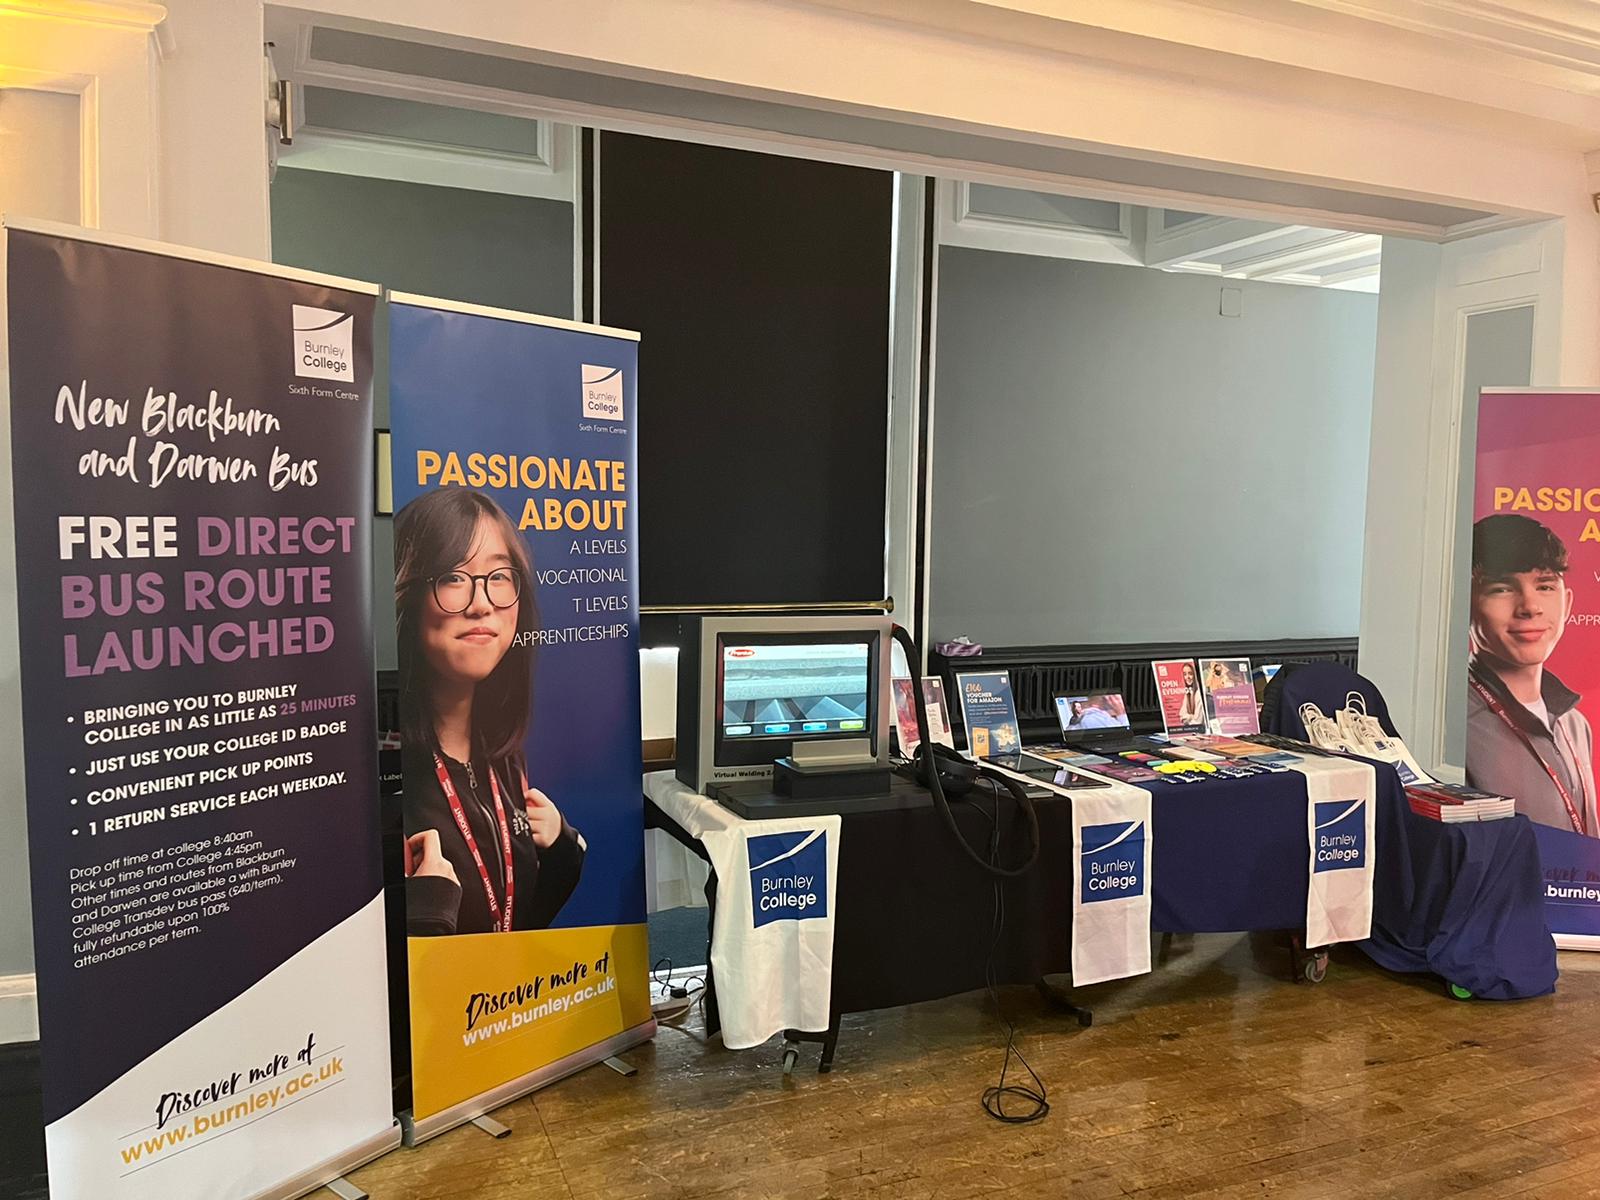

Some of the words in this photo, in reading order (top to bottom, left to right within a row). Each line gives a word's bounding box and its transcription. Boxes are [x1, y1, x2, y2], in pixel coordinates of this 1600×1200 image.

[303, 354, 347, 373] College
[304, 340, 345, 359] Burnley
[54, 379, 130, 431] New
[141, 387, 281, 442] Blackburn
[288, 384, 310, 395] Sixth
[312, 386, 333, 398] Form
[334, 389, 359, 401] Centre
[587, 401, 619, 415] College
[588, 390, 617, 404] Burnley
[78, 436, 140, 483] and
[147, 440, 257, 489] Darwen
[268, 446, 319, 492] Bus
[416, 450, 626, 492] PASSIONATE
[518, 498, 627, 531] ABOUT
[1493, 486, 1600, 512] PASSIO
[58, 516, 178, 560] FREE
[197, 516, 356, 556] DIRECT
[569, 540, 581, 555] A
[584, 539, 627, 555] LEVELS
[61, 572, 166, 619] BUS
[184, 566, 332, 611] ROUTE
[536, 568, 628, 585] VOCATIONAL
[572, 598, 580, 613] T
[586, 595, 628, 612] LEVELS
[63, 615, 335, 678] LAUNCHED
[511, 624, 629, 648] APPRENTICESHIPS
[84, 700, 170, 725] BRINGING
[173, 695, 209, 712] YOU
[212, 693, 234, 707] TO
[237, 684, 298, 704] BURNLEY
[1161, 680, 1179, 688] OPEN
[84, 721, 161, 745] COLLEGE
[165, 718, 183, 733] IN
[187, 714, 210, 729] AS
[214, 708, 255, 726] LITTLE
[258, 704, 277, 719] AS
[280, 703, 297, 715] 25
[301, 694, 357, 713] MINUTES
[85, 756, 126, 776] JUST
[130, 750, 160, 767] USE
[163, 742, 210, 762] YOUR
[213, 731, 278, 754] COLLEGE
[281, 729, 297, 742] ID
[300, 721, 347, 739] BADGE
[87, 773, 195, 806] CONVENIENT
[199, 765, 238, 784] PICK
[242, 761, 261, 777] UP
[264, 752, 314, 772] POINTS
[88, 821, 97, 836] 1
[103, 807, 166, 833] RETURN
[170, 793, 236, 818] SERVICE
[240, 784, 279, 804] EACH
[281, 771, 347, 795] WEEKDAY.
[69, 864, 102, 880] Drop
[104, 858, 121, 872] off
[123, 853, 149, 867] time
[151, 848, 164, 859] at
[166, 839, 212, 856] college
[213, 830, 253, 846] 8:40am
[1317, 848, 1360, 862] College
[1320, 834, 1357, 848] Burnley
[70, 879, 97, 894] Pick
[99, 876, 116, 888] up
[118, 868, 144, 883] time
[146, 861, 174, 876] from
[176, 850, 222, 868] College
[224, 841, 263, 857] 4:45pm
[71, 892, 107, 909] Other
[110, 883, 141, 900] times
[143, 875, 168, 890] and
[170, 869, 206, 884] routes
[208, 861, 234, 875] from
[235, 848, 285, 868] Blackburn
[761, 875, 814, 893] Burnley
[1088, 875, 1138, 891] College
[1091, 859, 1136, 876] Burnley
[71, 908, 98, 925] and
[101, 896, 147, 917] Darwen
[149, 890, 170, 903] are
[172, 876, 226, 897] available
[228, 874, 237, 883] a
[239, 868, 260, 881] with
[261, 857, 297, 874] Burnley
[72, 918, 121, 939] College
[123, 902, 175, 925] Transdev
[177, 897, 198, 910] bus
[200, 890, 226, 906] pass
[228, 874, 284, 898] (£40/term).
[760, 892, 817, 911] College
[73, 938, 98, 954] fully
[100, 920, 165, 946] refundable
[168, 911, 199, 927] upon
[202, 902, 230, 917] 100%
[74, 939, 147, 969] attendance
[149, 932, 169, 947] per
[172, 924, 202, 940] term.
[462, 976, 616, 1047] www.burnley.ac.uk
[466, 975, 544, 1031] Discover
[550, 961, 588, 989] more
[594, 951, 610, 976] at
[155, 1072, 242, 1130] Discover
[249, 1054, 289, 1084] more
[297, 1032, 316, 1065] at
[120, 1056, 344, 1164] www.burnley.ac.uk
